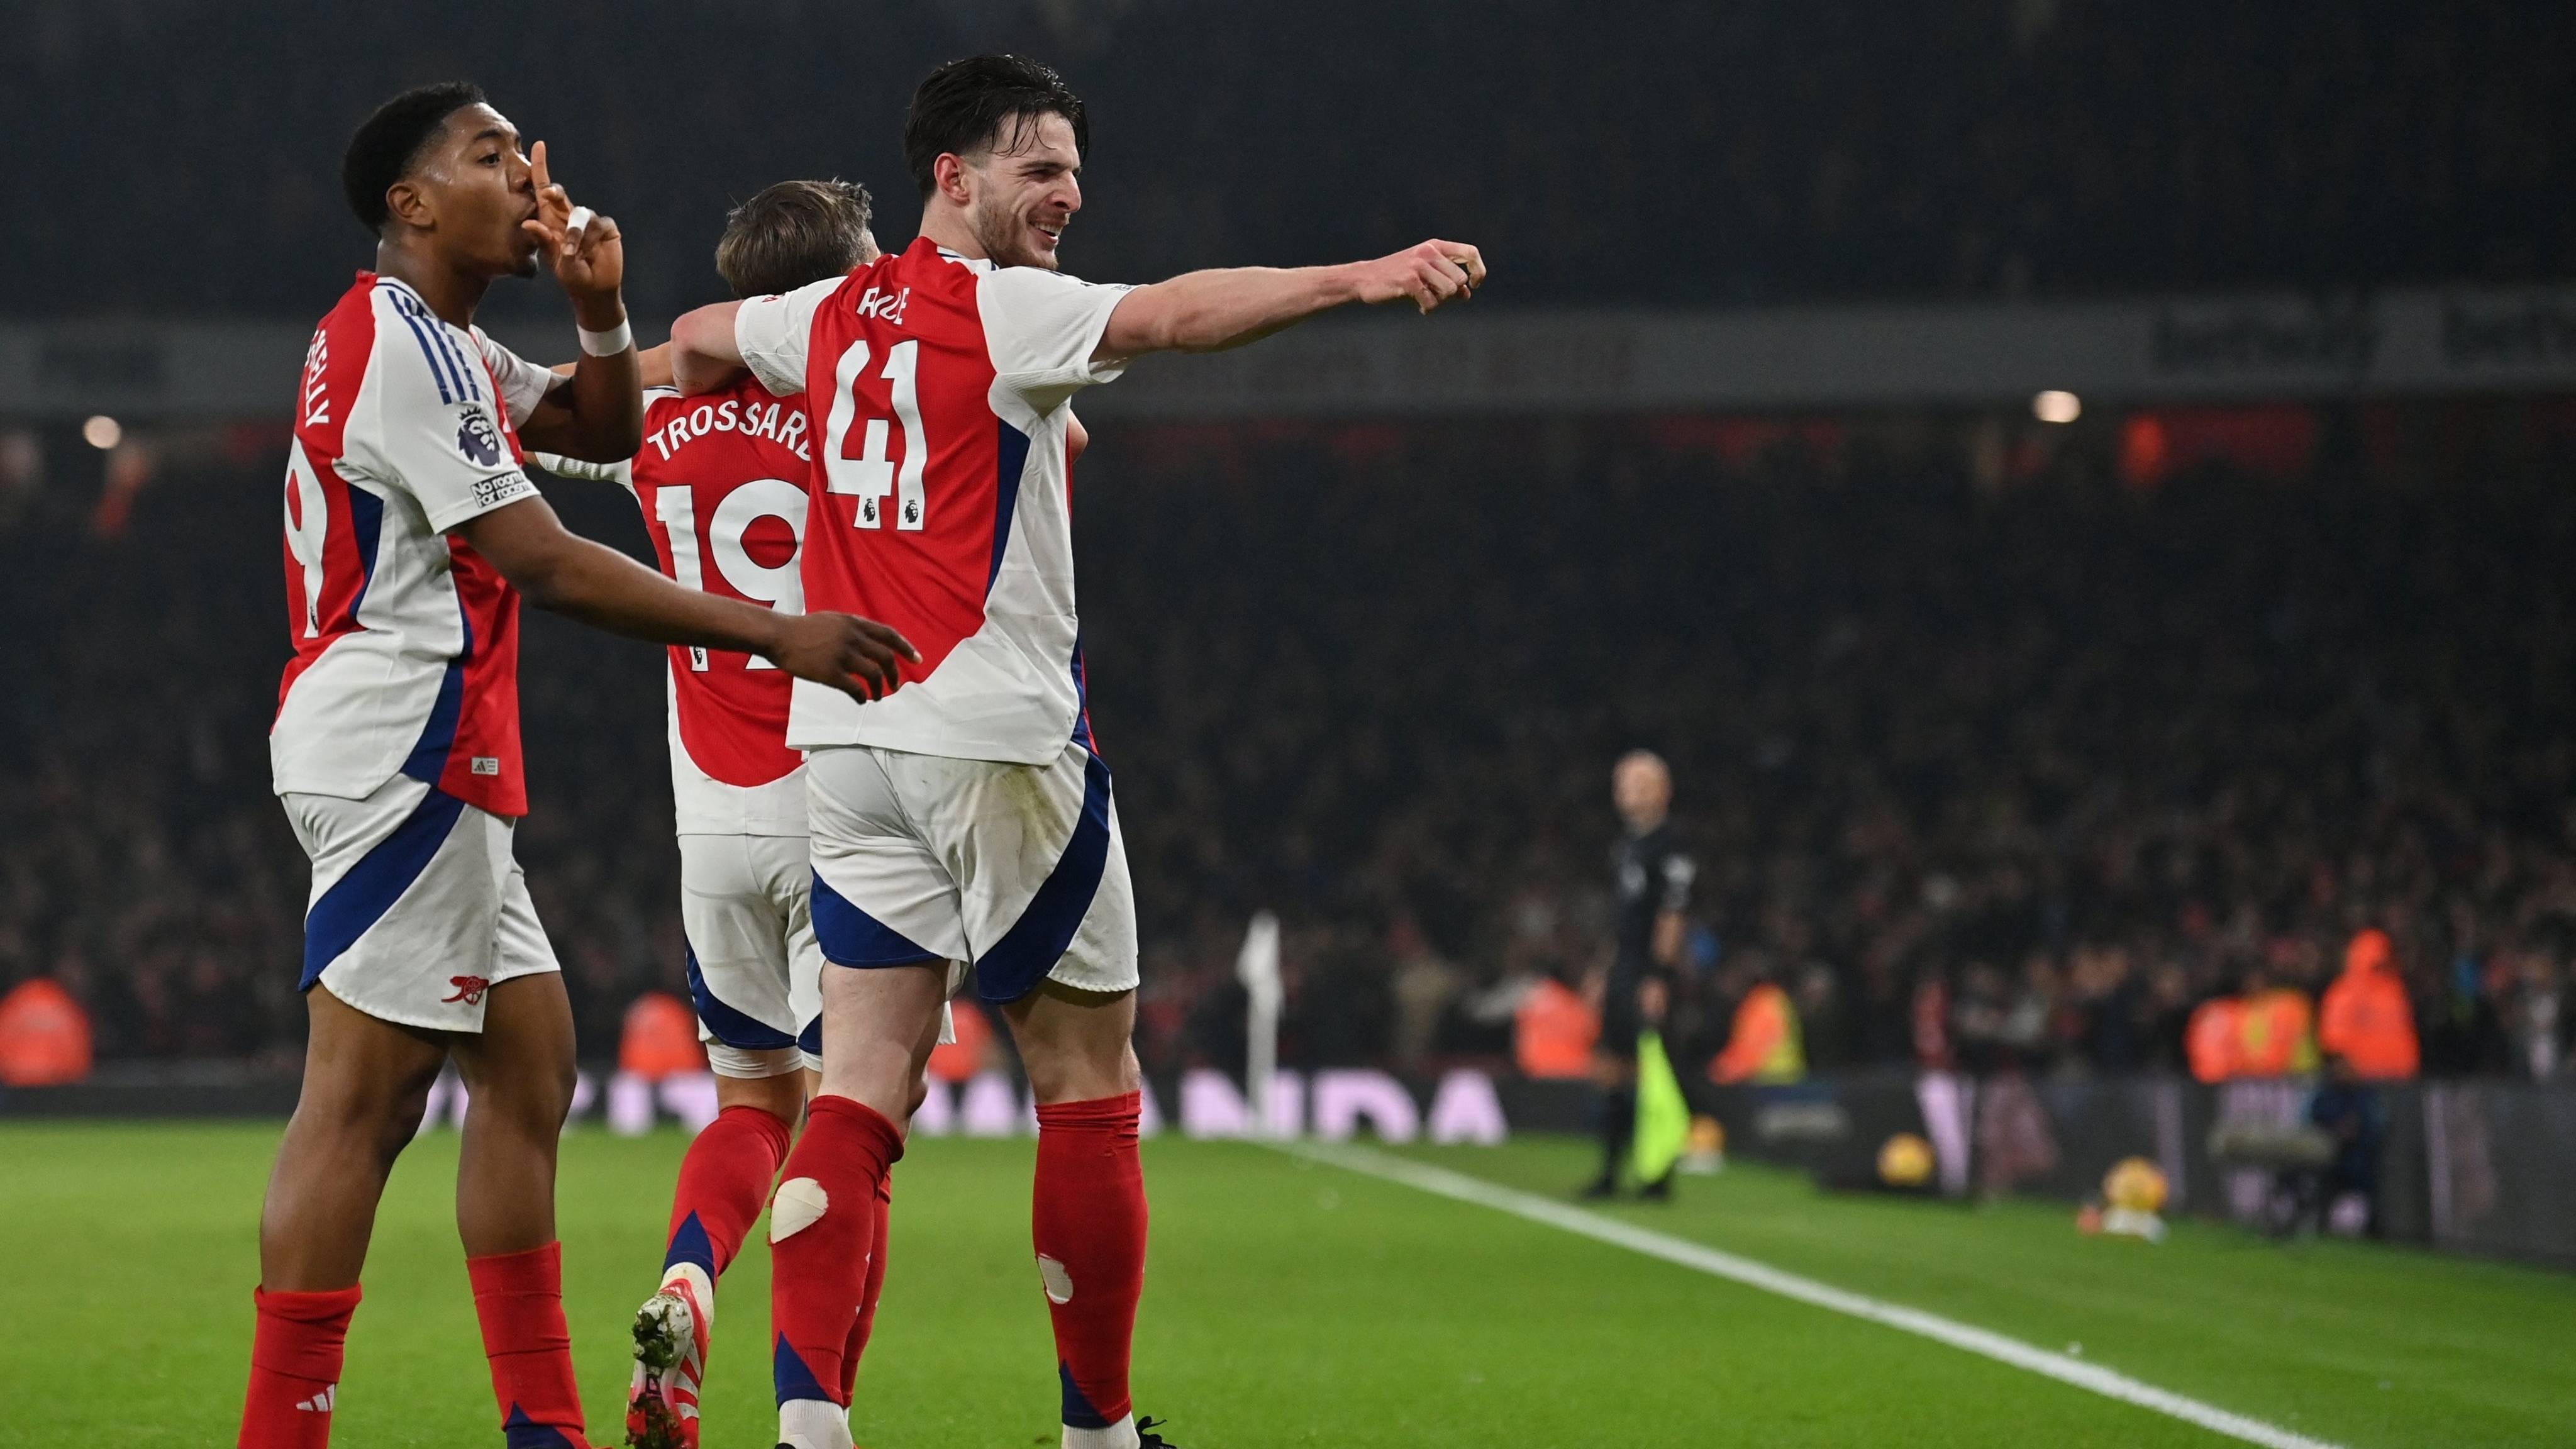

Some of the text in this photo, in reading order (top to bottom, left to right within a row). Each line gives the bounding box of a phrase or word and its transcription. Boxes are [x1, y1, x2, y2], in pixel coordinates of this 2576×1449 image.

[472, 482, 493, 499] No
[824, 340, 928, 530] 41
[655, 479, 811, 672] 19
